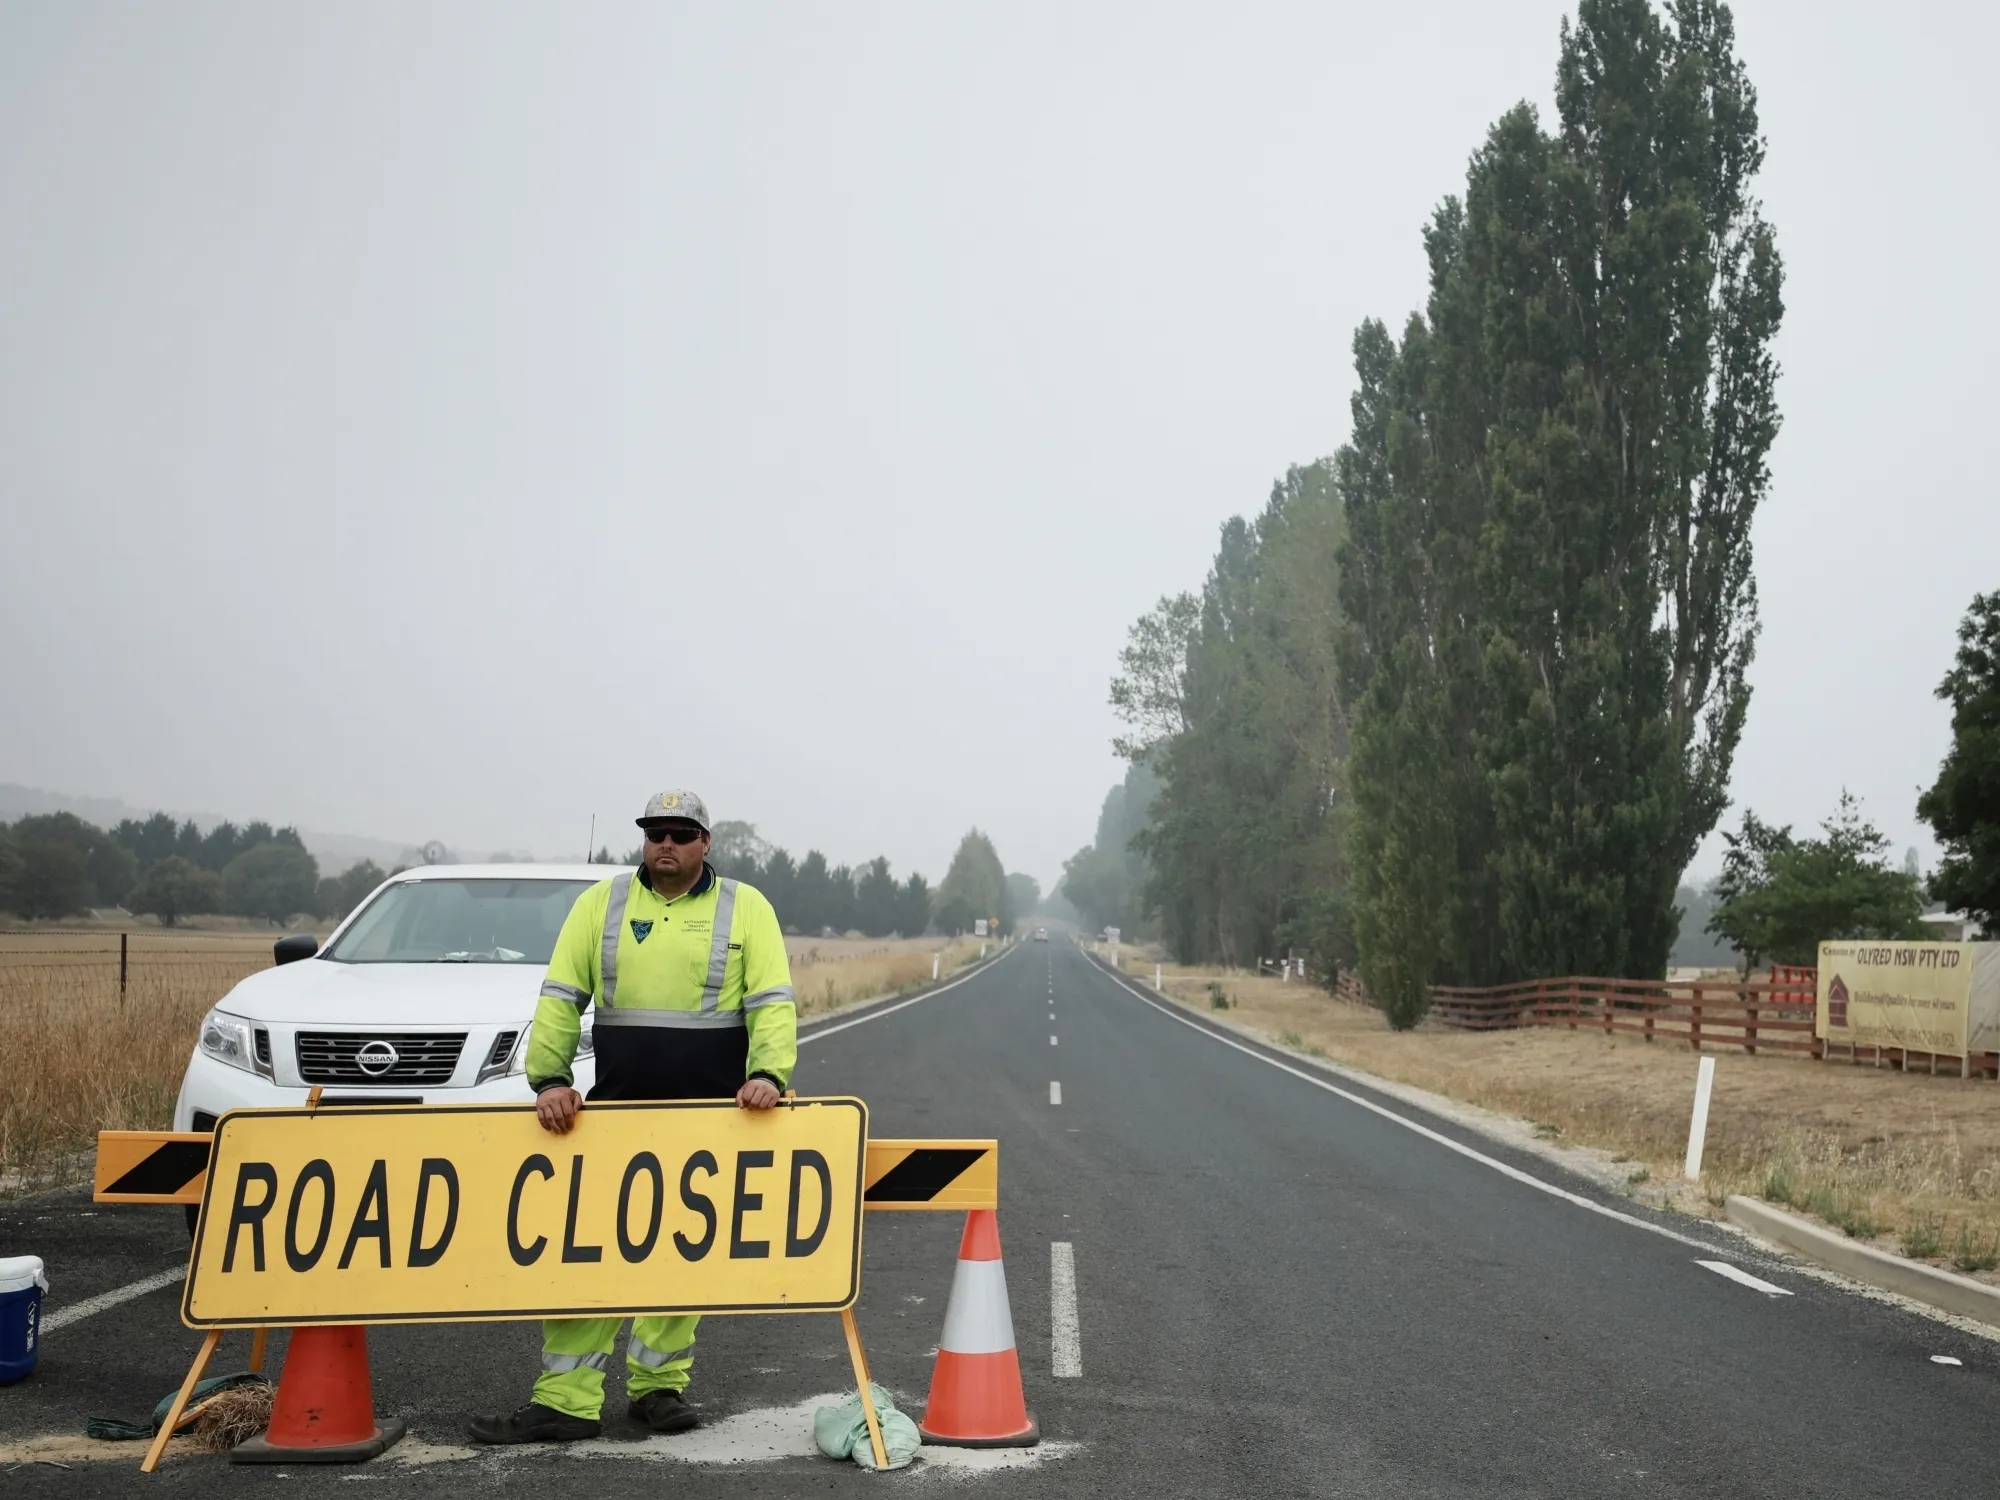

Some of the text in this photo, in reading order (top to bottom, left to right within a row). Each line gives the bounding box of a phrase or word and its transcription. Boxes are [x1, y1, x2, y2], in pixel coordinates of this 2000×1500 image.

[1857, 948, 1892, 966] OLYRED
[1894, 948, 1916, 966] NSW
[1919, 949, 1939, 969] PTY
[1941, 949, 1960, 968] LTD
[221, 1149, 832, 1273] ROAD CLOSED
